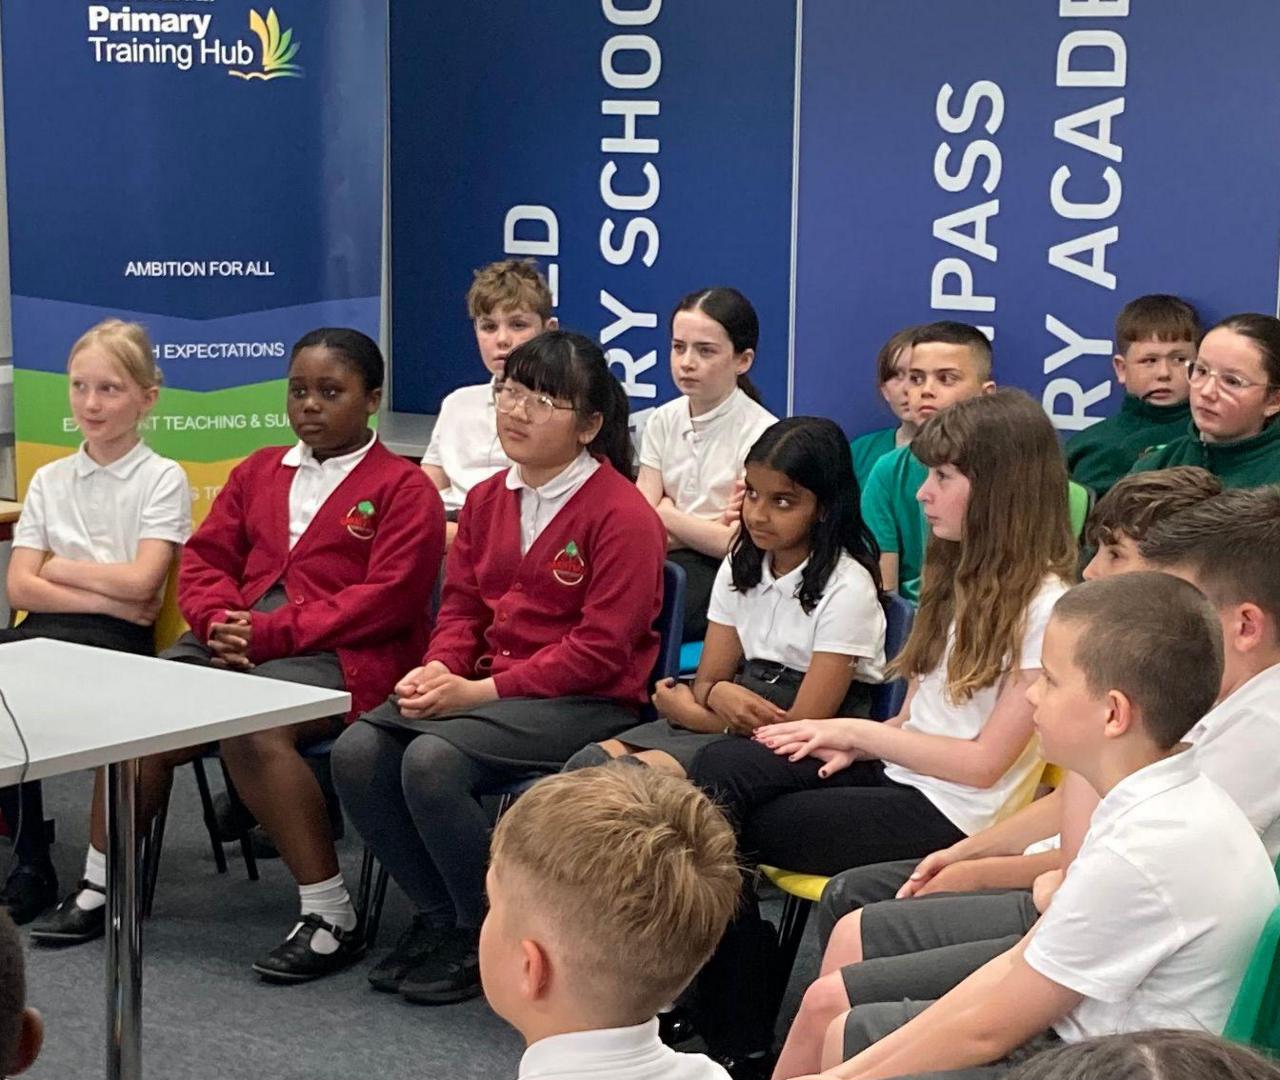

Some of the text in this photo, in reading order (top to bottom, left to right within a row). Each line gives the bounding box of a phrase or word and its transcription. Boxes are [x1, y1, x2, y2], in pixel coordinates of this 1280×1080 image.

[88, 5, 212, 39] Primary
[88, 36, 253, 70] Training Hub
[931, 80, 1005, 341] PASS
[125, 261, 275, 276] AMBITION FOR ALL
[164, 342, 285, 359] EXPECTATIONS
[163, 414, 247, 431] TEACHING
[250, 414, 261, 427] &
